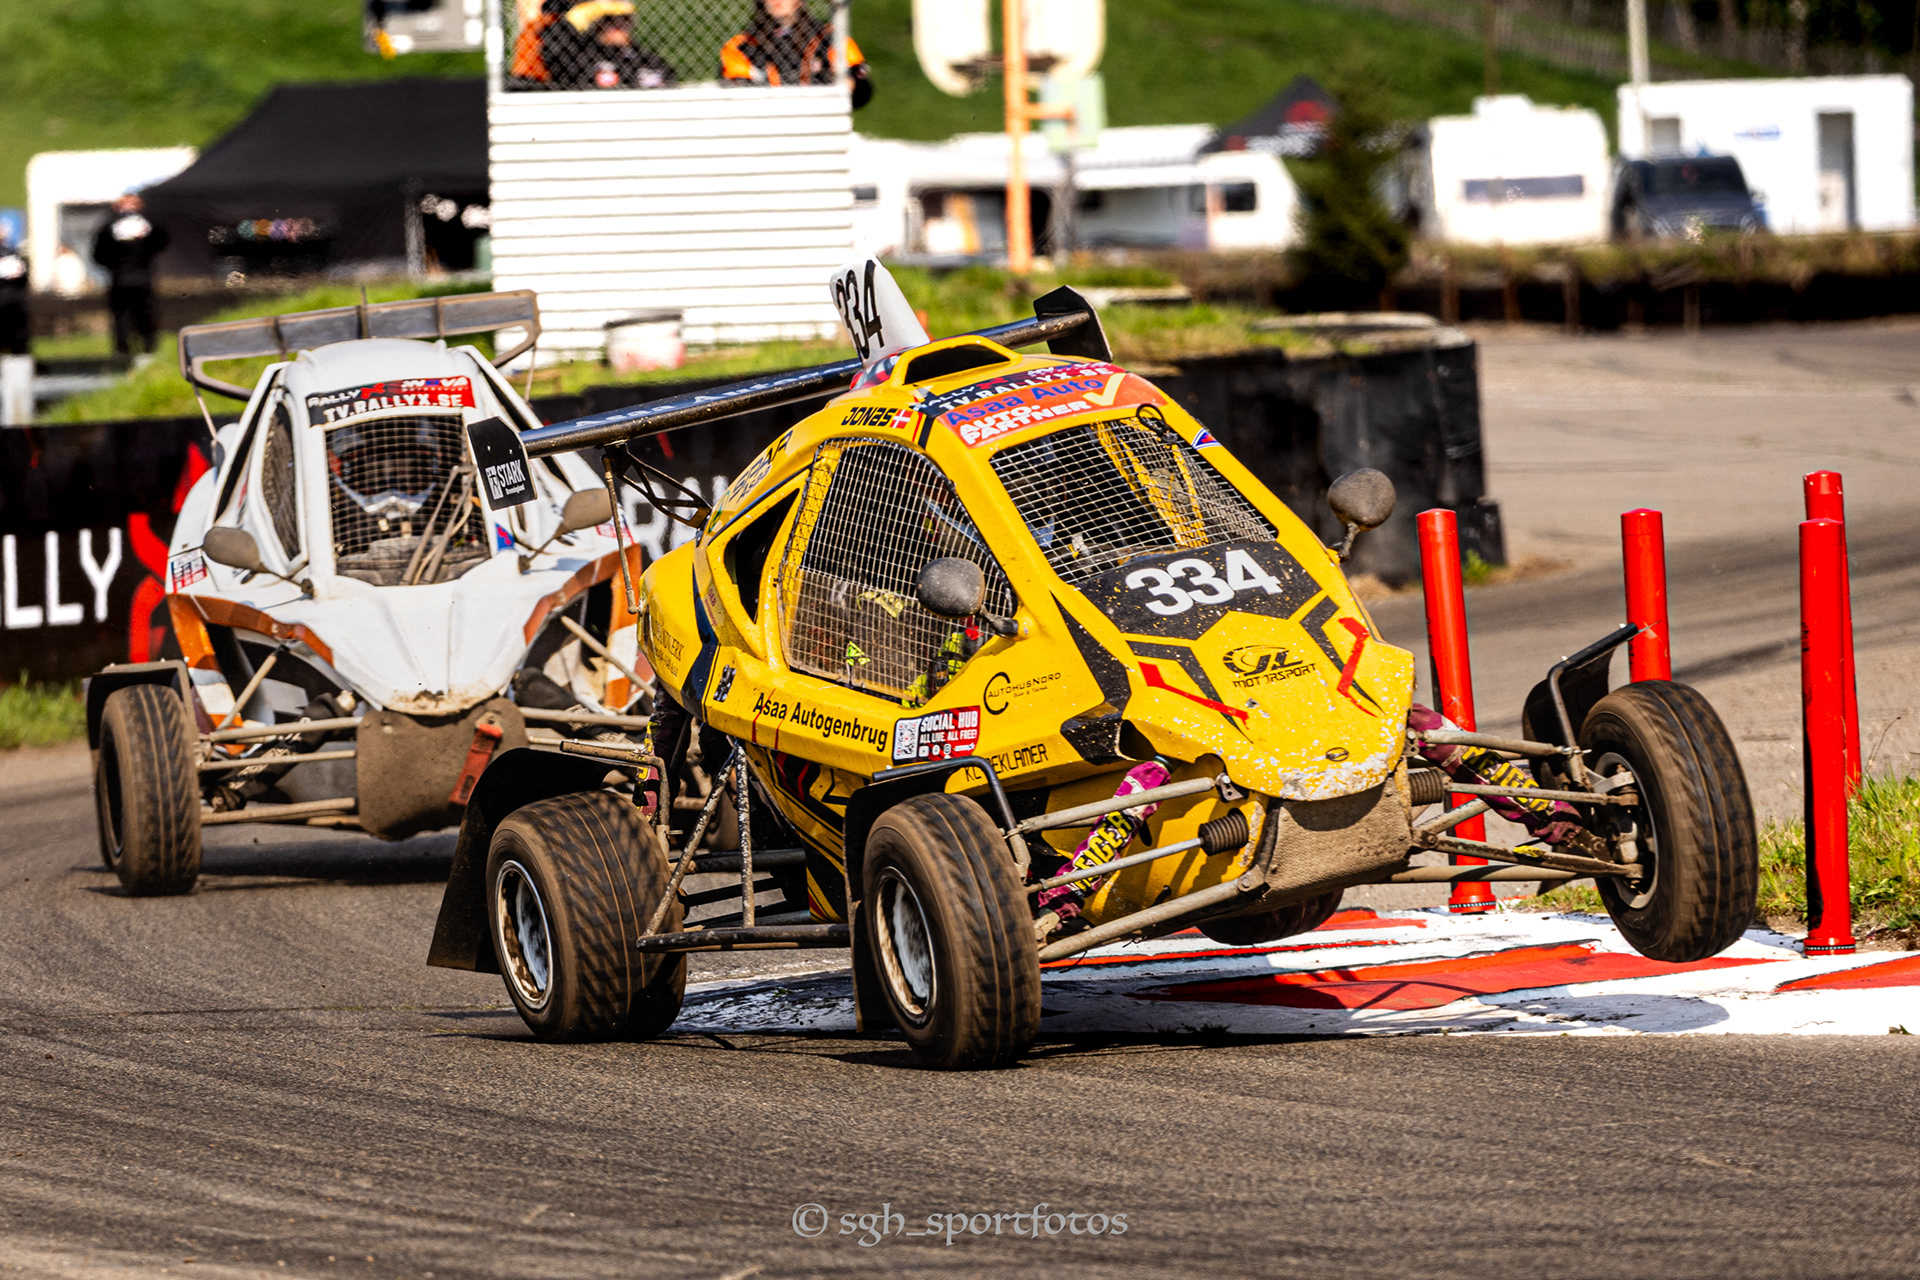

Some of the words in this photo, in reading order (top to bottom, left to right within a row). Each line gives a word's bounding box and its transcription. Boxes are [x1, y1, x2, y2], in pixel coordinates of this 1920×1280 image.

[836, 259, 885, 361] 334
[323, 394, 464, 422] TV.RALLYX.SE
[950, 391, 1027, 426] Asaa
[1030, 379, 1104, 401] Auto
[962, 401, 1091, 445] PARTNER
[497, 459, 526, 488] STARK
[1125, 549, 1283, 616] 334
[753, 692, 788, 720] Asaa
[790, 702, 888, 752] Autogenbrug
[920, 712, 955, 732] SOCIAL
[958, 711, 978, 729] HUB
